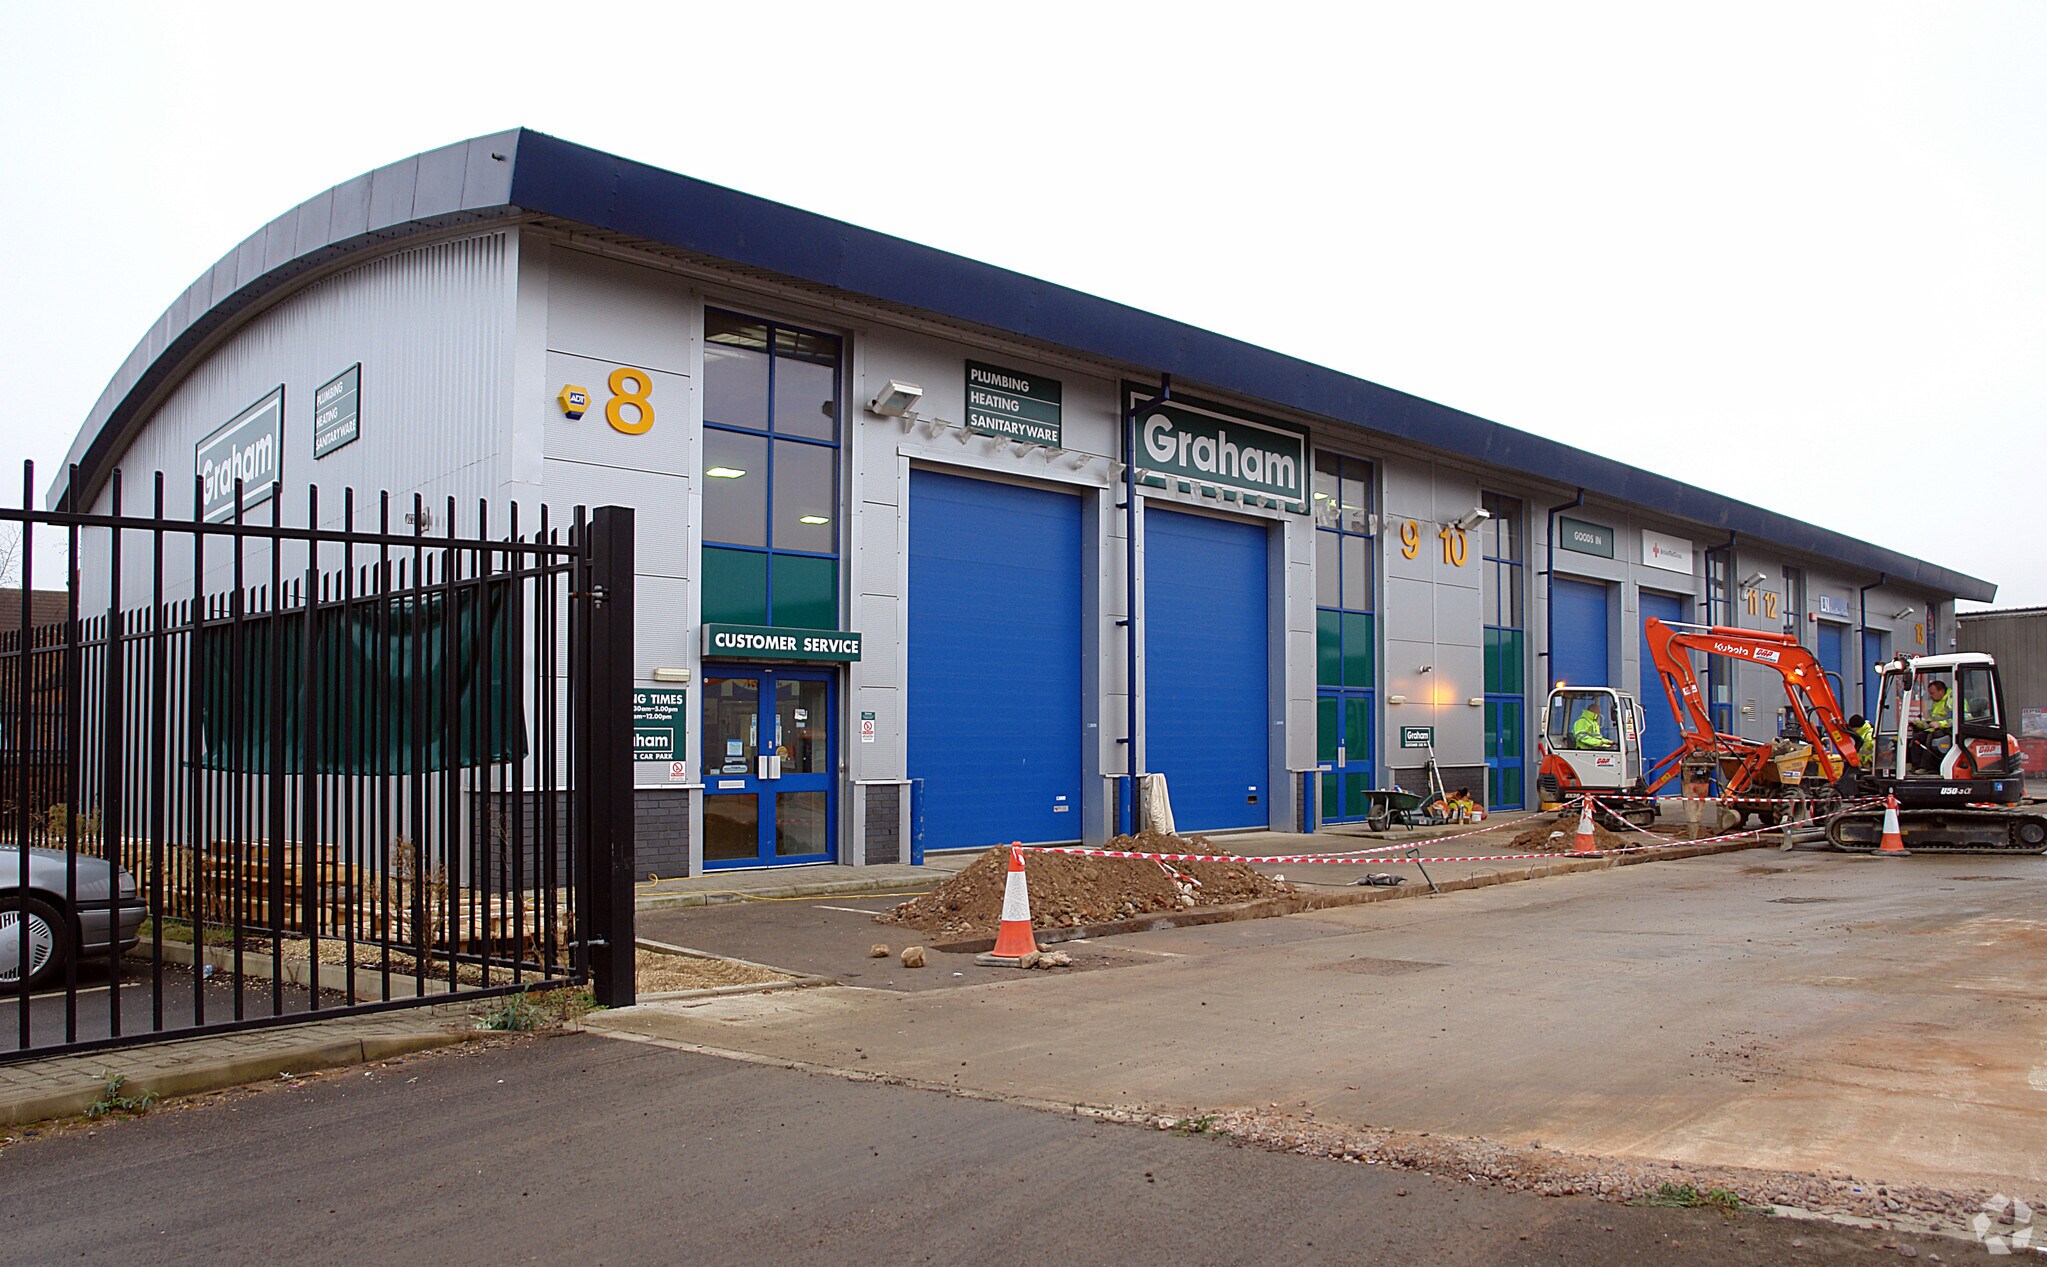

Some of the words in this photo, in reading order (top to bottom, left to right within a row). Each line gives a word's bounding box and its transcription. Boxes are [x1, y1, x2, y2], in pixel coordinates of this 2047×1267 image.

[971, 368, 1030, 393] PLUMBING
[316, 381, 344, 406] PLUMBING
[570, 394, 585, 403] ADT
[606, 367, 655, 435] 8
[970, 391, 1020, 412] HEATING
[316, 407, 338, 429] HEATING
[970, 413, 1058, 442] SANITARYWARE
[316, 419, 356, 451] SANITARYWARE
[1143, 413, 1295, 489] Graham
[203, 433, 273, 506] Graham
[1400, 519, 1420, 560] 9
[1439, 527, 1468, 568] 10
[1574, 531, 1594, 543] GOODS
[1595, 535, 1602, 545] IN
[1763, 592, 1778, 619] 12
[715, 632, 797, 651] CUSTOMER
[803, 638, 859, 654] SERVICE
[1714, 642, 1749, 656] Kubota
[650, 694, 683, 705] TIMES
[1407, 731, 1429, 740] Graham
